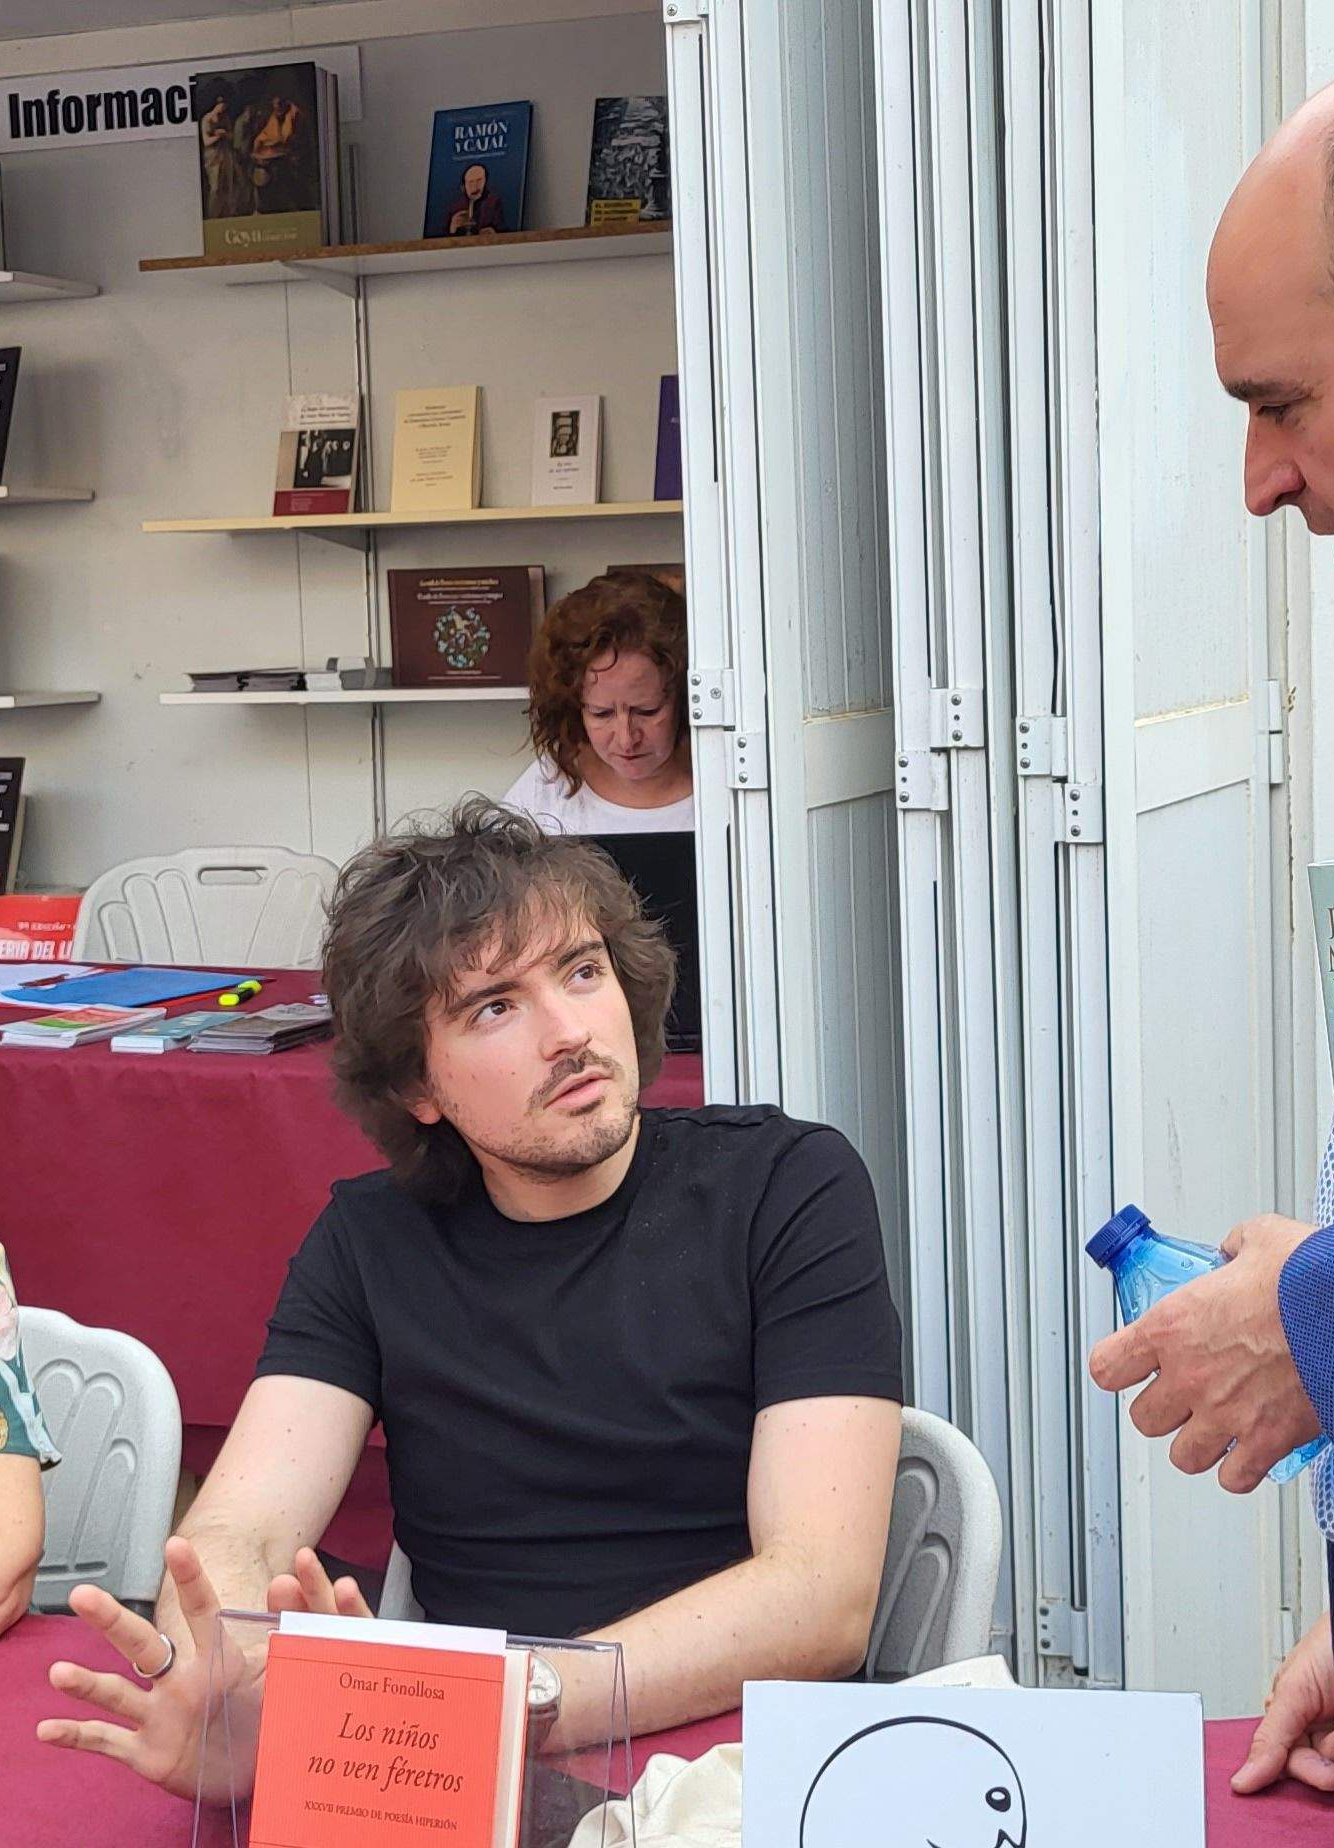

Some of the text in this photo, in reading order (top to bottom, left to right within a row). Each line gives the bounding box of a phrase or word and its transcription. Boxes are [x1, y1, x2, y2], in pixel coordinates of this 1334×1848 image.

[454, 119, 507, 139] RAMÓN
[463, 135, 507, 152] CAJAL
[31, 940, 56, 960] DEL
[339, 1671, 445, 1700] Omar Fonollosa
[337, 1712, 439, 1750] Los niños
[308, 1755, 464, 1793] no ven féretros
[304, 1801, 458, 1831] XXXVII PREMIO DE POESÍA HIPERIÓN
